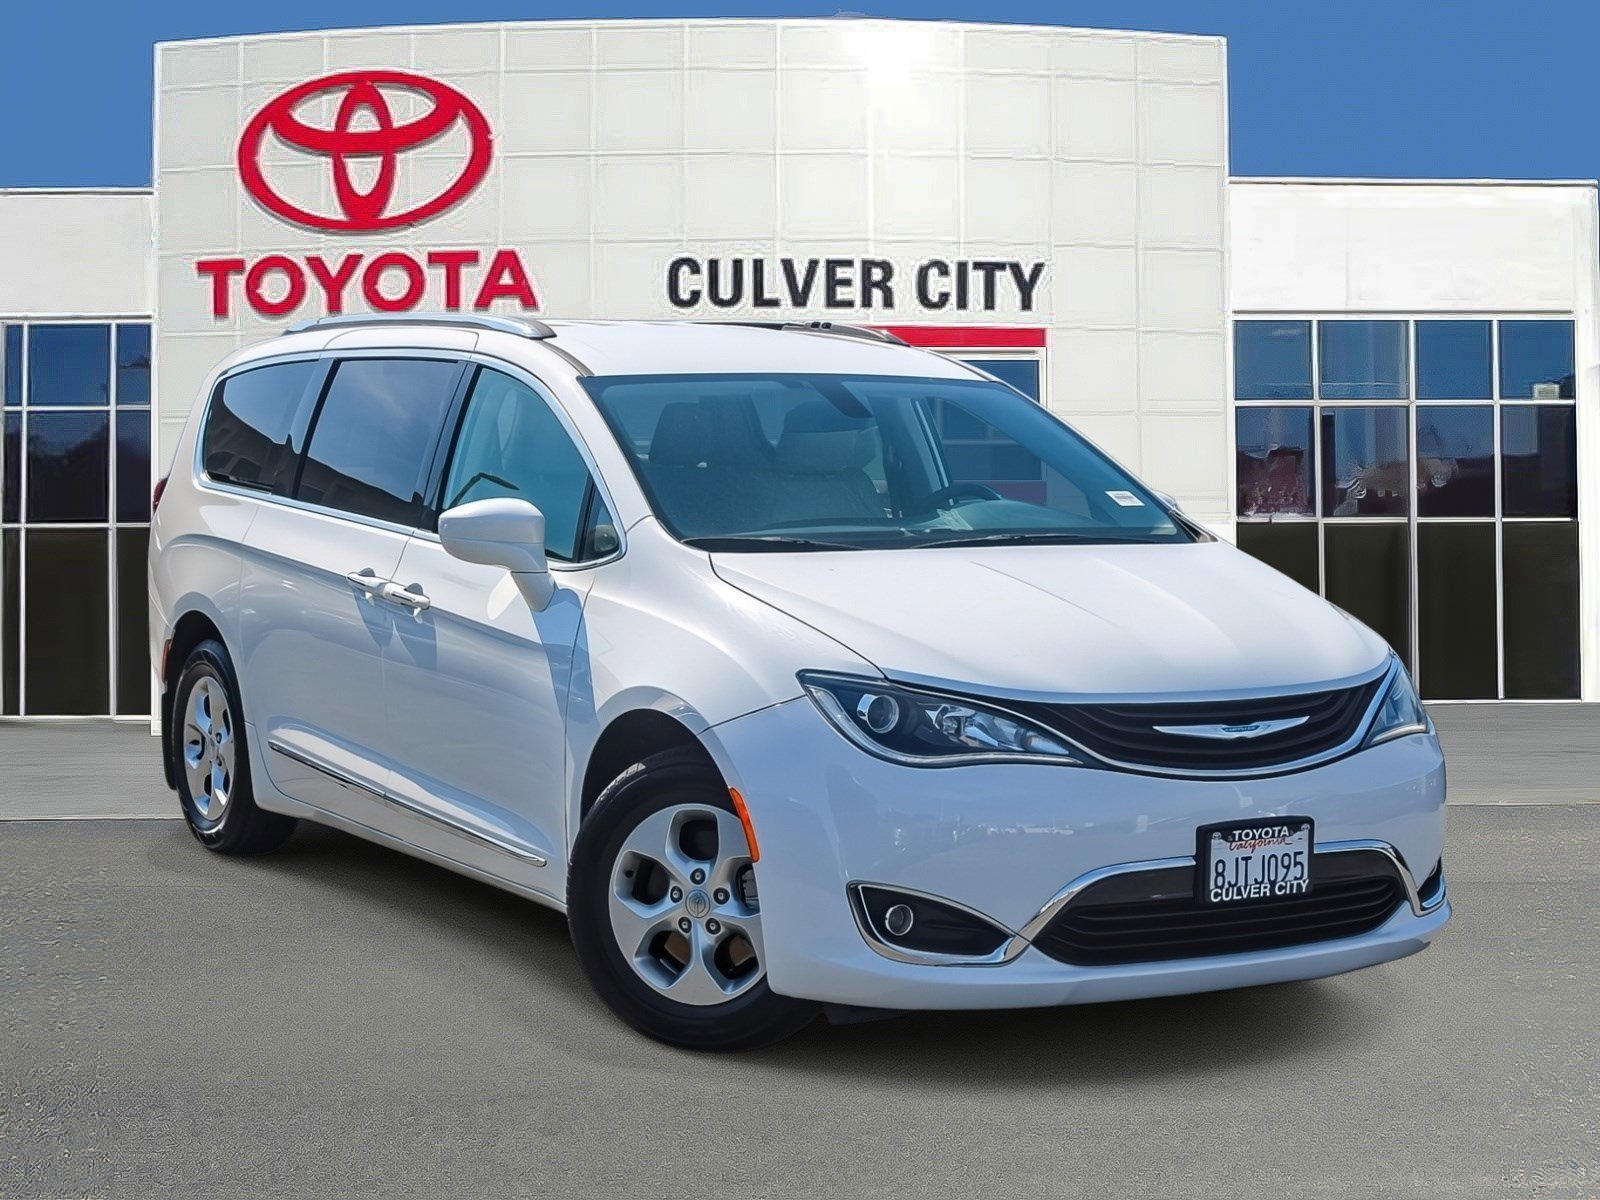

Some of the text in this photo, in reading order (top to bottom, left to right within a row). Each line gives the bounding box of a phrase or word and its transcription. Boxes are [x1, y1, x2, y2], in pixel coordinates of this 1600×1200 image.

[196, 248, 538, 319] TOYOTA
[667, 257, 1046, 311] CULVER CITY
[1228, 836, 1293, 854] California
[1232, 826, 1290, 841] TOYOTA
[1214, 850, 1305, 888] 8JTJ095
[1210, 878, 1310, 903] CULVER CITY
